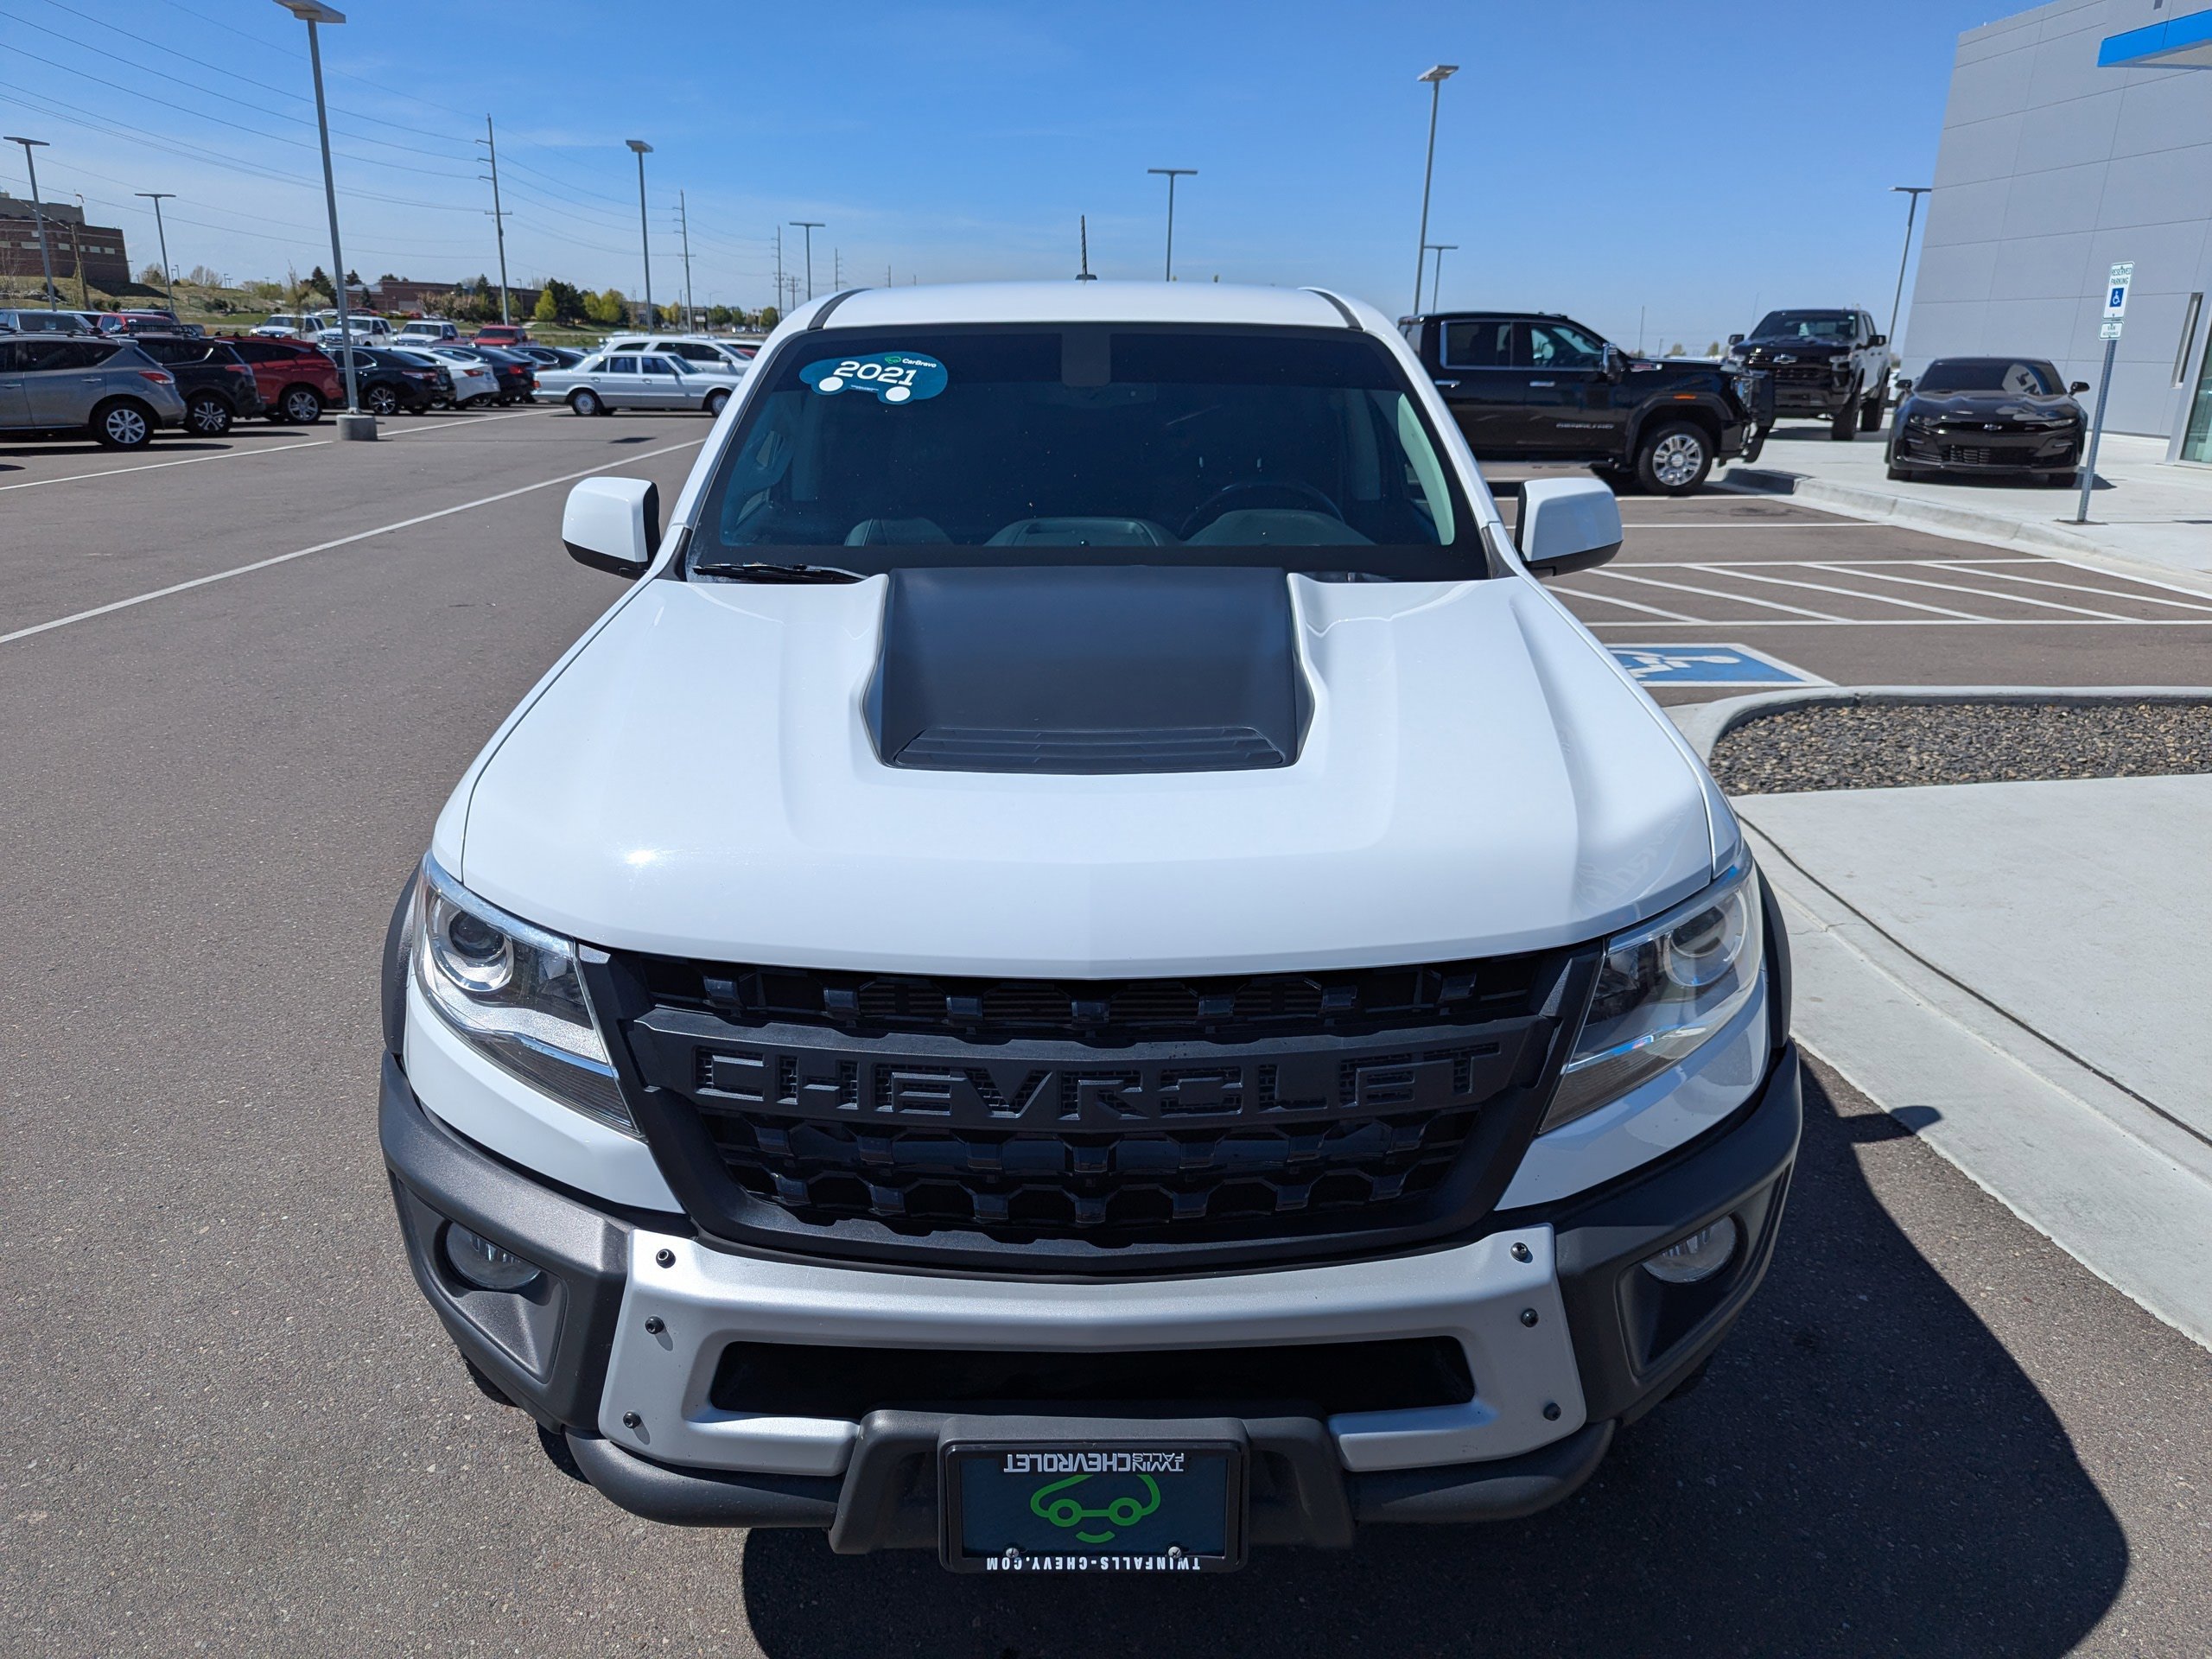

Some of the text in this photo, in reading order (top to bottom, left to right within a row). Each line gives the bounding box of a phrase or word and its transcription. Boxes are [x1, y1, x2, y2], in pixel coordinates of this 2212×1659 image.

[902, 358, 937, 368] CarBravo
[833, 360, 917, 386] 2021
[694, 1042, 1501, 1121] CHEVROLET
[1003, 1452, 1131, 1473] CHEVROLET
[1131, 1452, 1185, 1463] FALLS
[1133, 1462, 1185, 1472] TWIN
[986, 1556, 1201, 1571] TWINFALLS-CHEVY.COM
